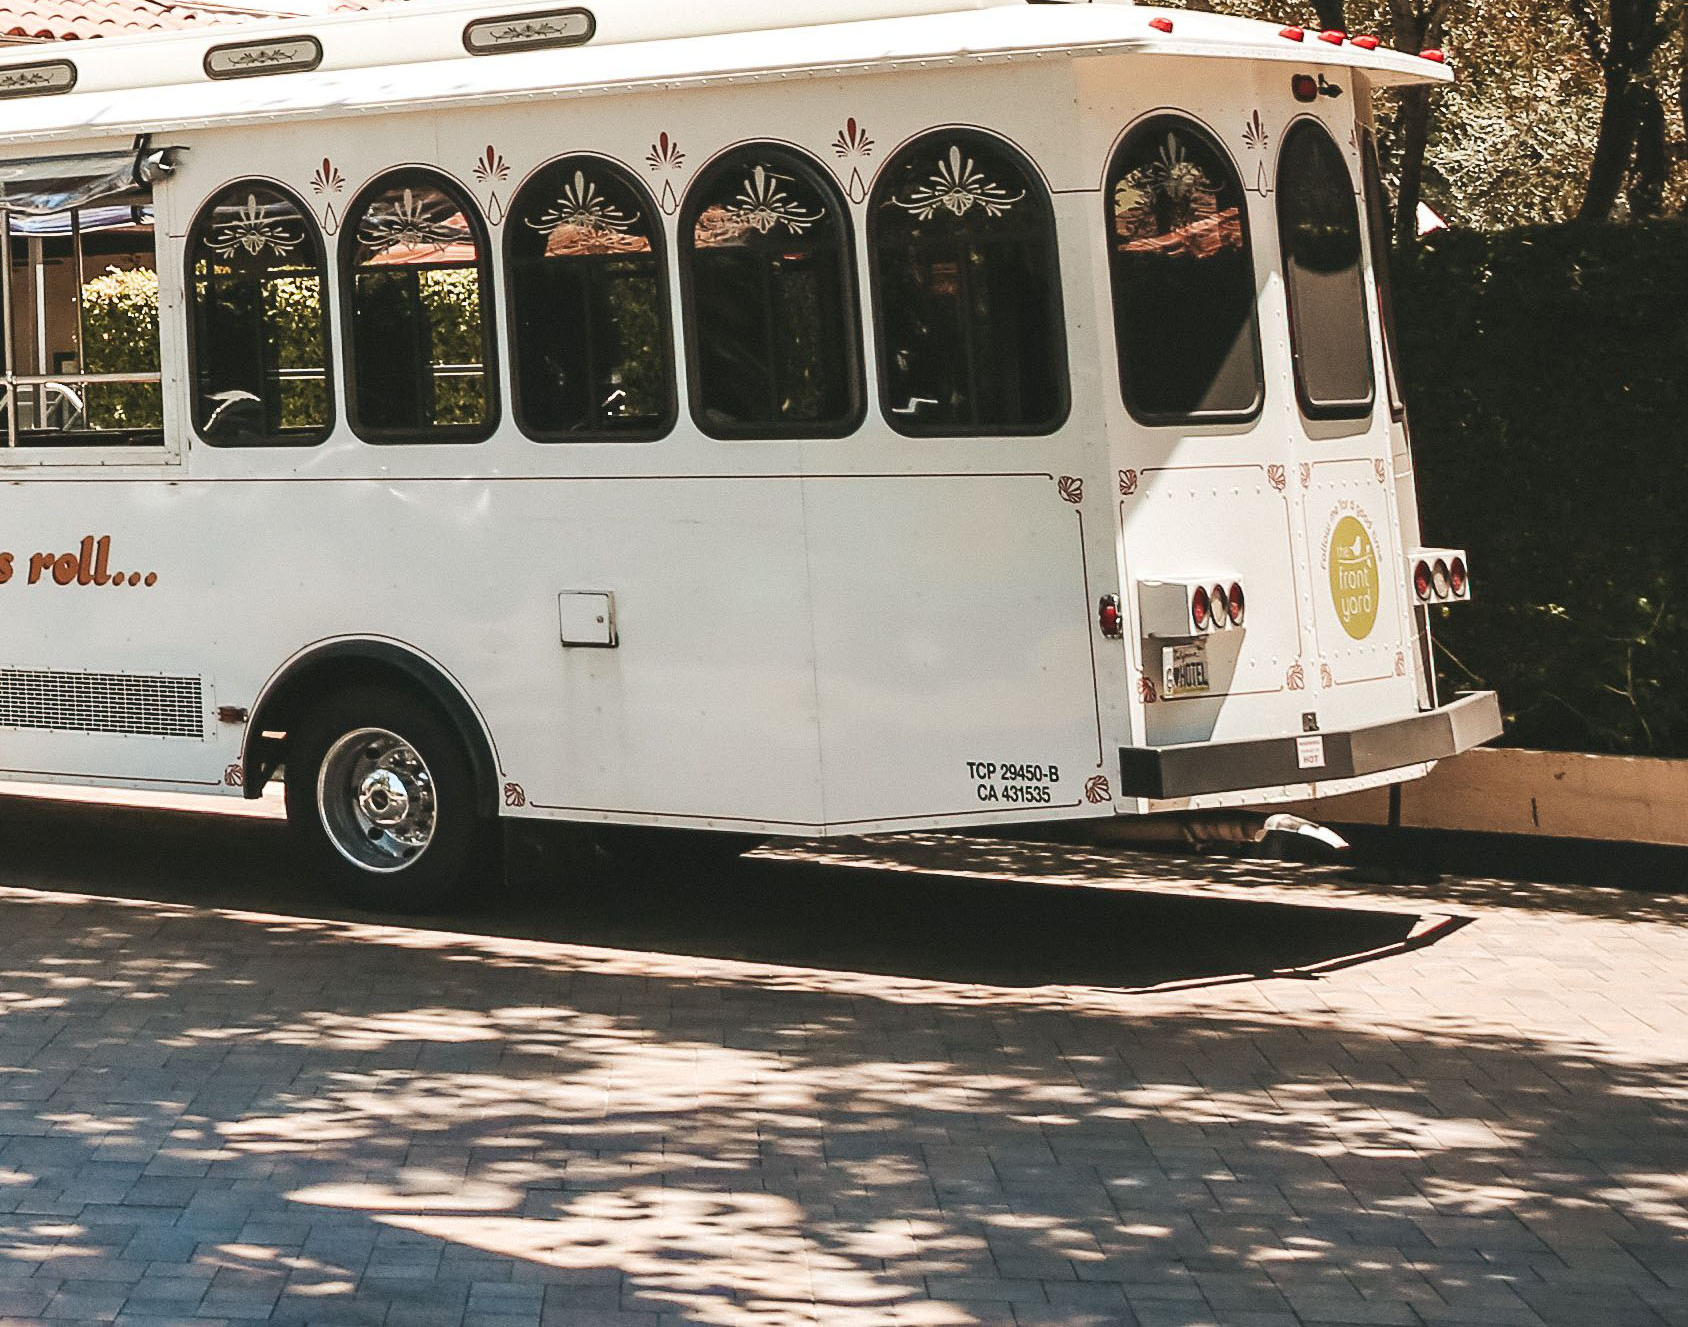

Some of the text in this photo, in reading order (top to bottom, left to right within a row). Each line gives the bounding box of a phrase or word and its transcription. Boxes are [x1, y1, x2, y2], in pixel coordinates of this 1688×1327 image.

[27, 535, 158, 587] roll...
[1338, 566, 1371, 590] front
[1340, 592, 1372, 623] yard
[966, 761, 1059, 783] TCP 29450-B
[977, 783, 1051, 803] CA 431535
